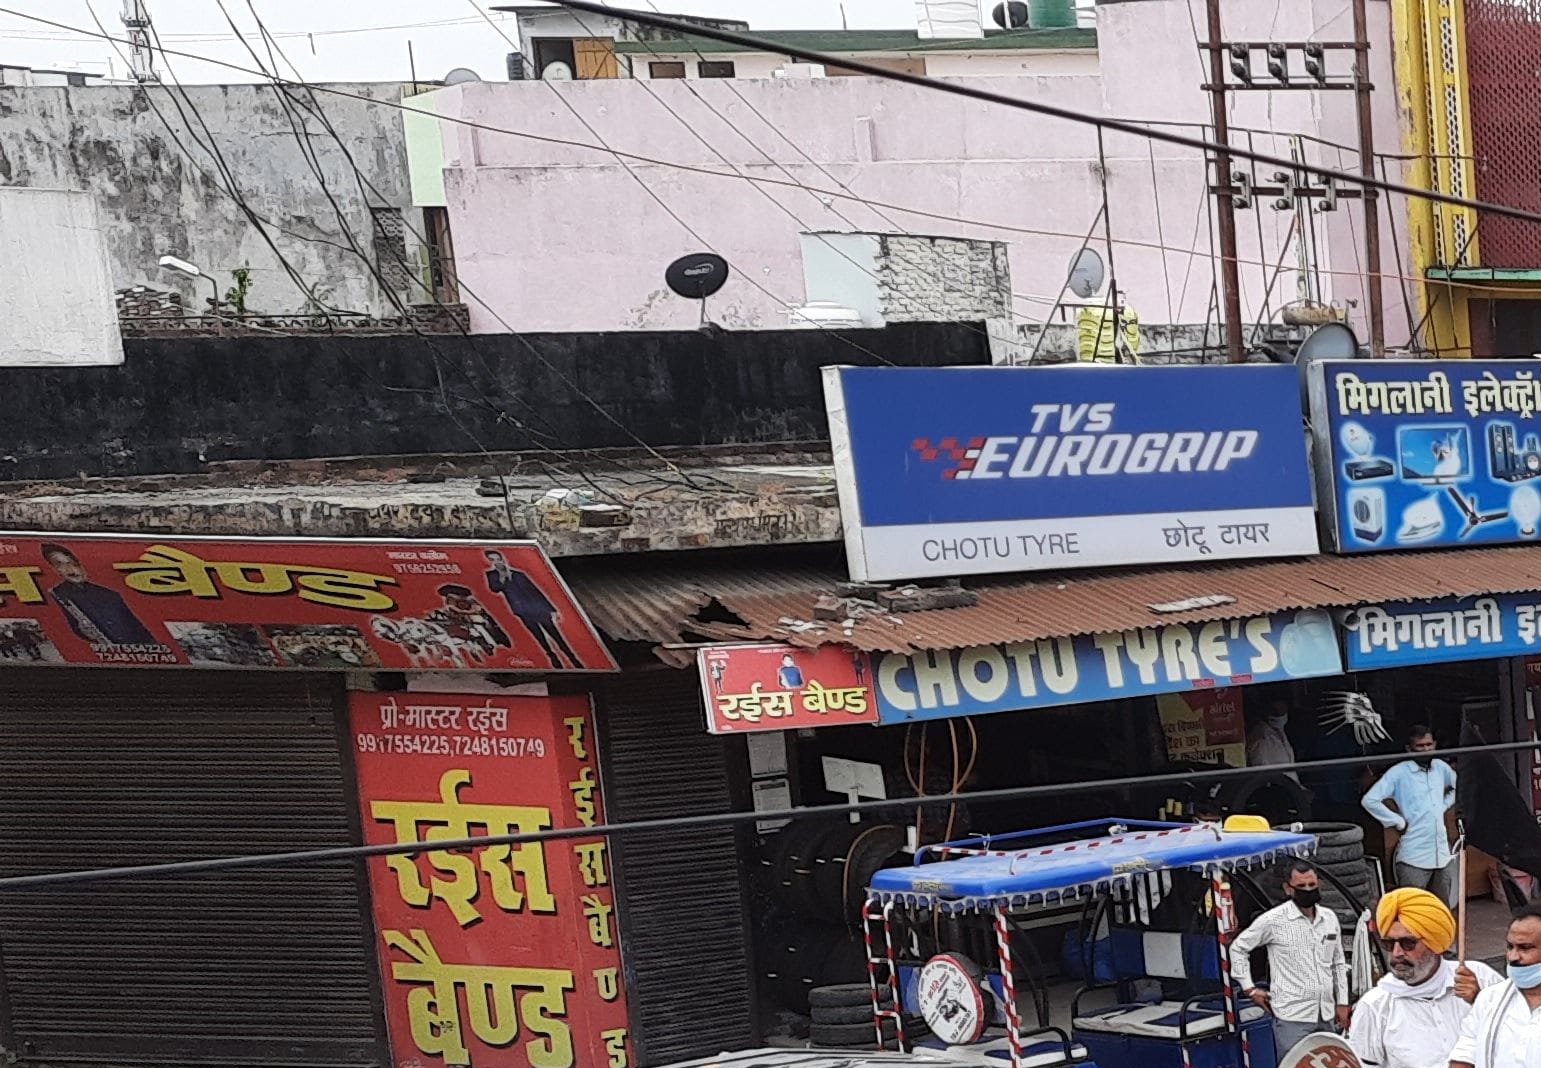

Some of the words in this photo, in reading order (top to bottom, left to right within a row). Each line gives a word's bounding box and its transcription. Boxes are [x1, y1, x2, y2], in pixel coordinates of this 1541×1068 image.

[1336, 371, 1453, 415] मिगलानी
[1030, 402, 1116, 434] TVS
[968, 429, 1258, 480] EUROGRIP
[921, 536, 1011, 562] CHOTU
[1015, 532, 1080, 556] TYRE
[1161, 518, 1212, 555] छोटू
[1218, 522, 1271, 546] टायर
[113, 545, 397, 610] बैण्ड
[1357, 597, 1503, 654] मिगलानी
[877, 637, 1079, 711] CHOTU
[1094, 616, 1280, 688] TYRE'S
[467, 699, 509, 735] रईस
[717, 685, 793, 722] रईस
[802, 682, 869, 714] बैण्ड
[370, 768, 557, 928] रईस
